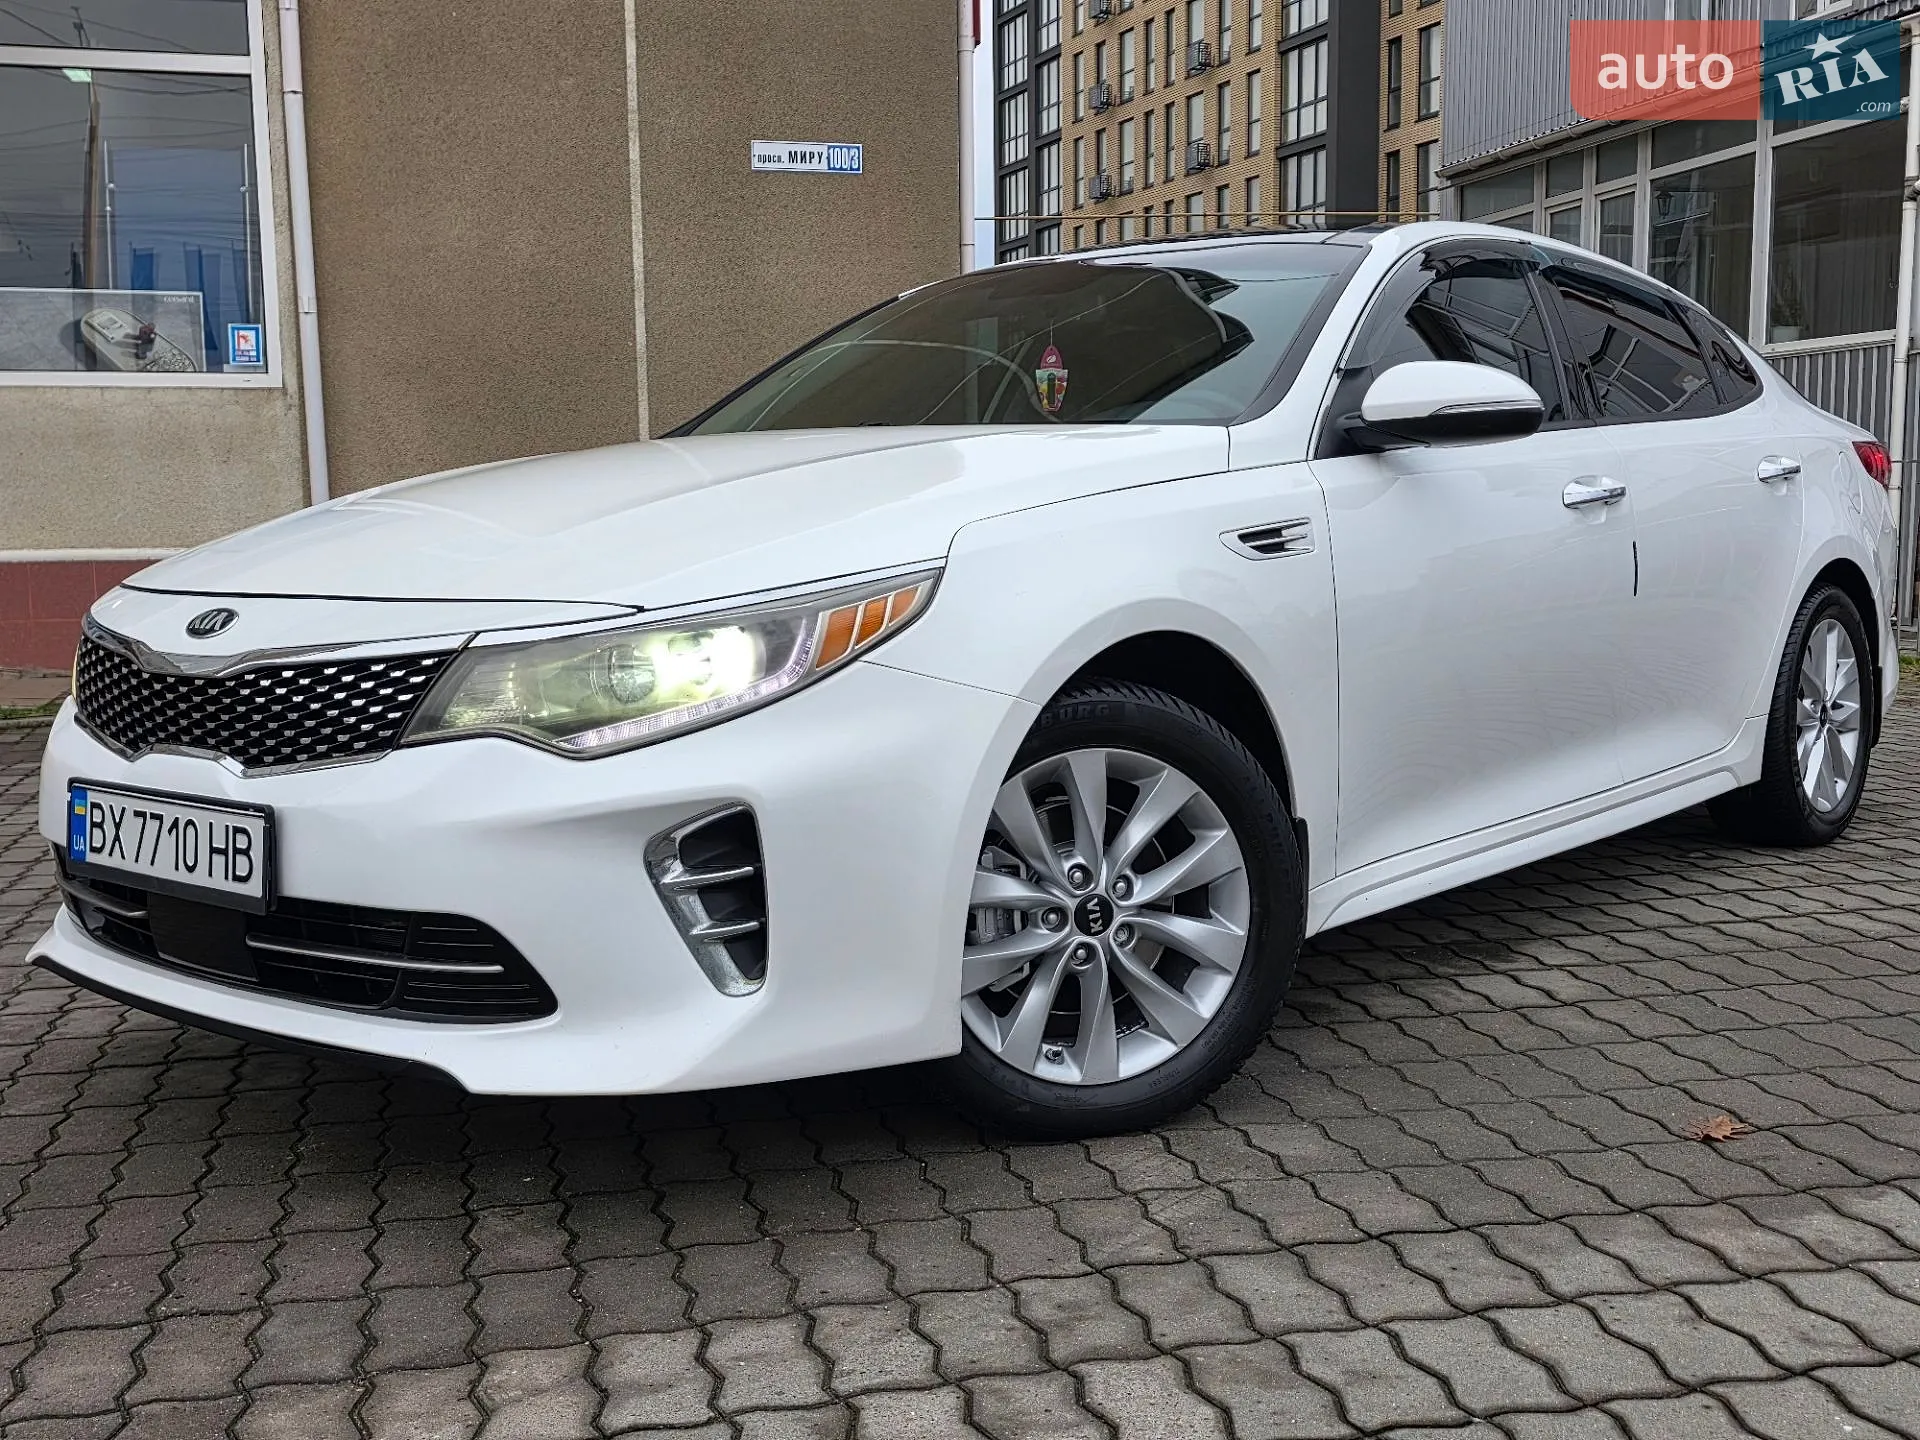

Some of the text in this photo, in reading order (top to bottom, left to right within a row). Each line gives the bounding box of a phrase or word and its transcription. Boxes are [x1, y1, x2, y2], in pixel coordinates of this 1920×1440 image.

[788, 150, 824, 164] МИРУ
[828, 147, 859, 170] 100/3
[73, 834, 85, 851] UA
[89, 801, 254, 882] BX 7710 HB
[1087, 897, 1104, 933] KIA
